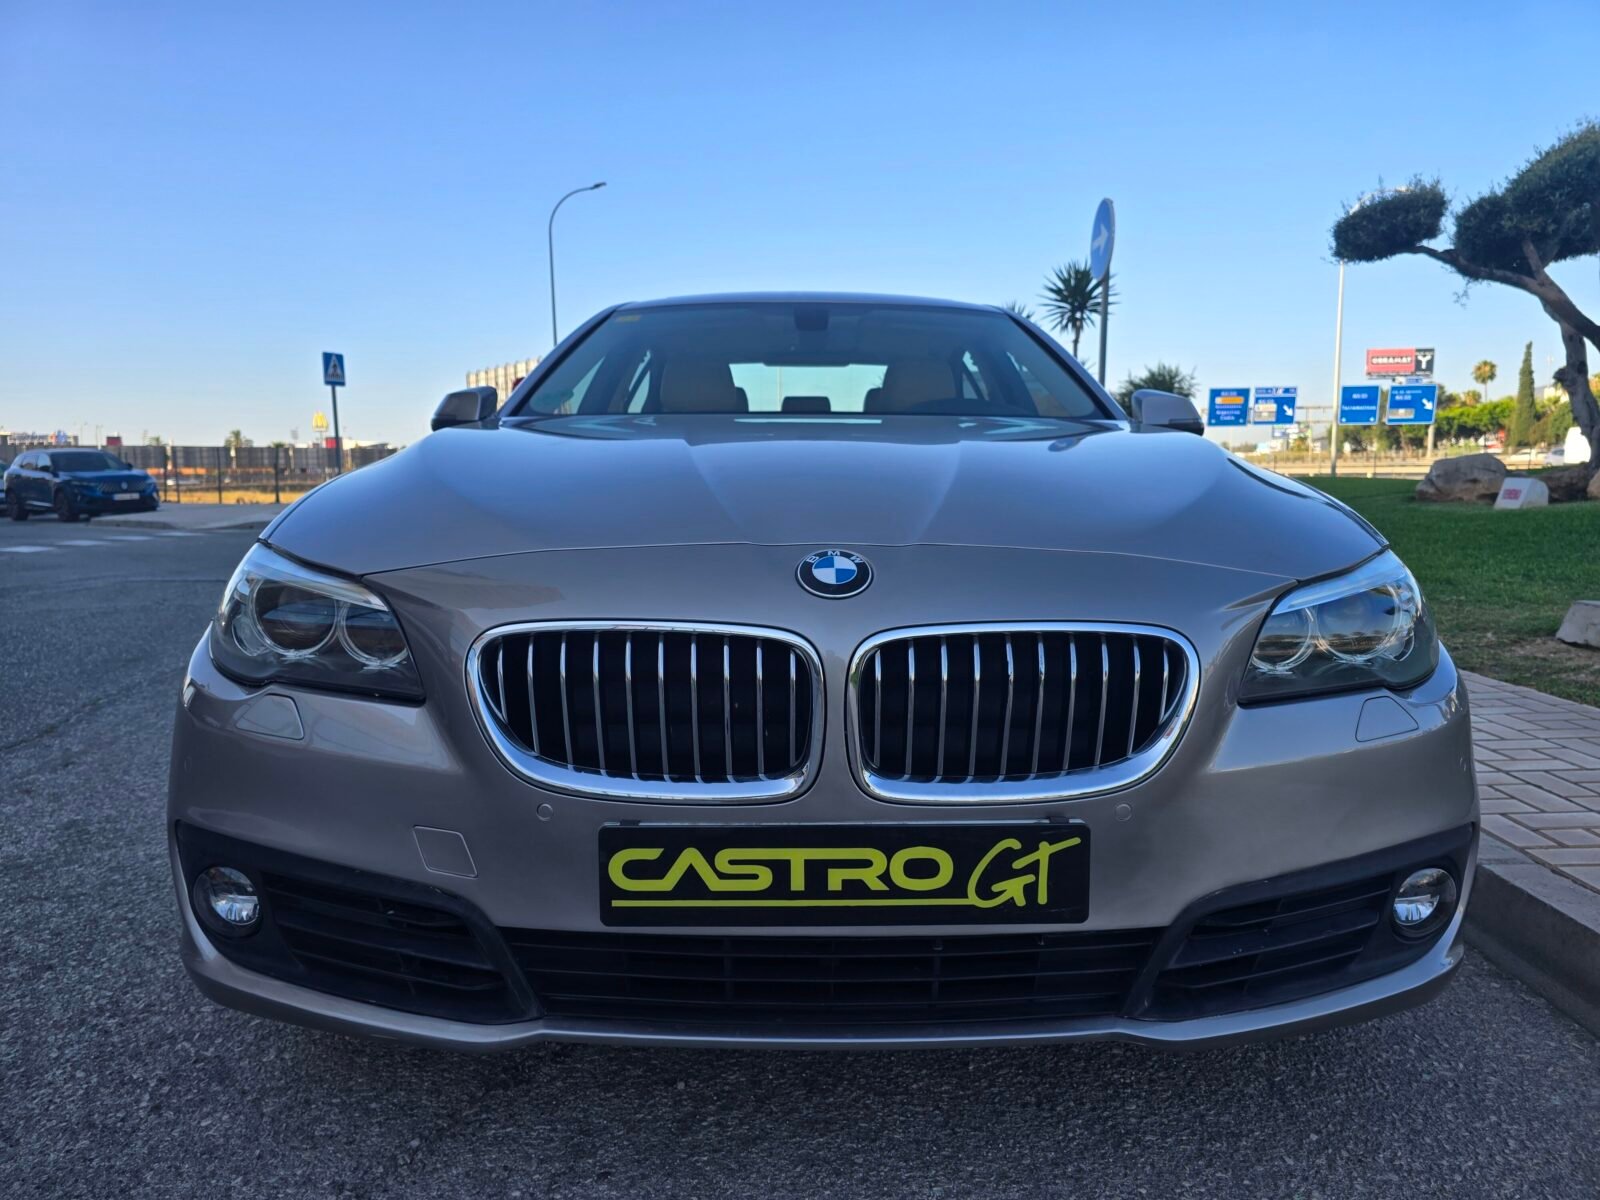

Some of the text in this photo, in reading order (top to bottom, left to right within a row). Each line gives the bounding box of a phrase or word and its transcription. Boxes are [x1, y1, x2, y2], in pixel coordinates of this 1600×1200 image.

[805, 550, 864, 563] BMW
[608, 837, 1081, 908] CASTRO GT
